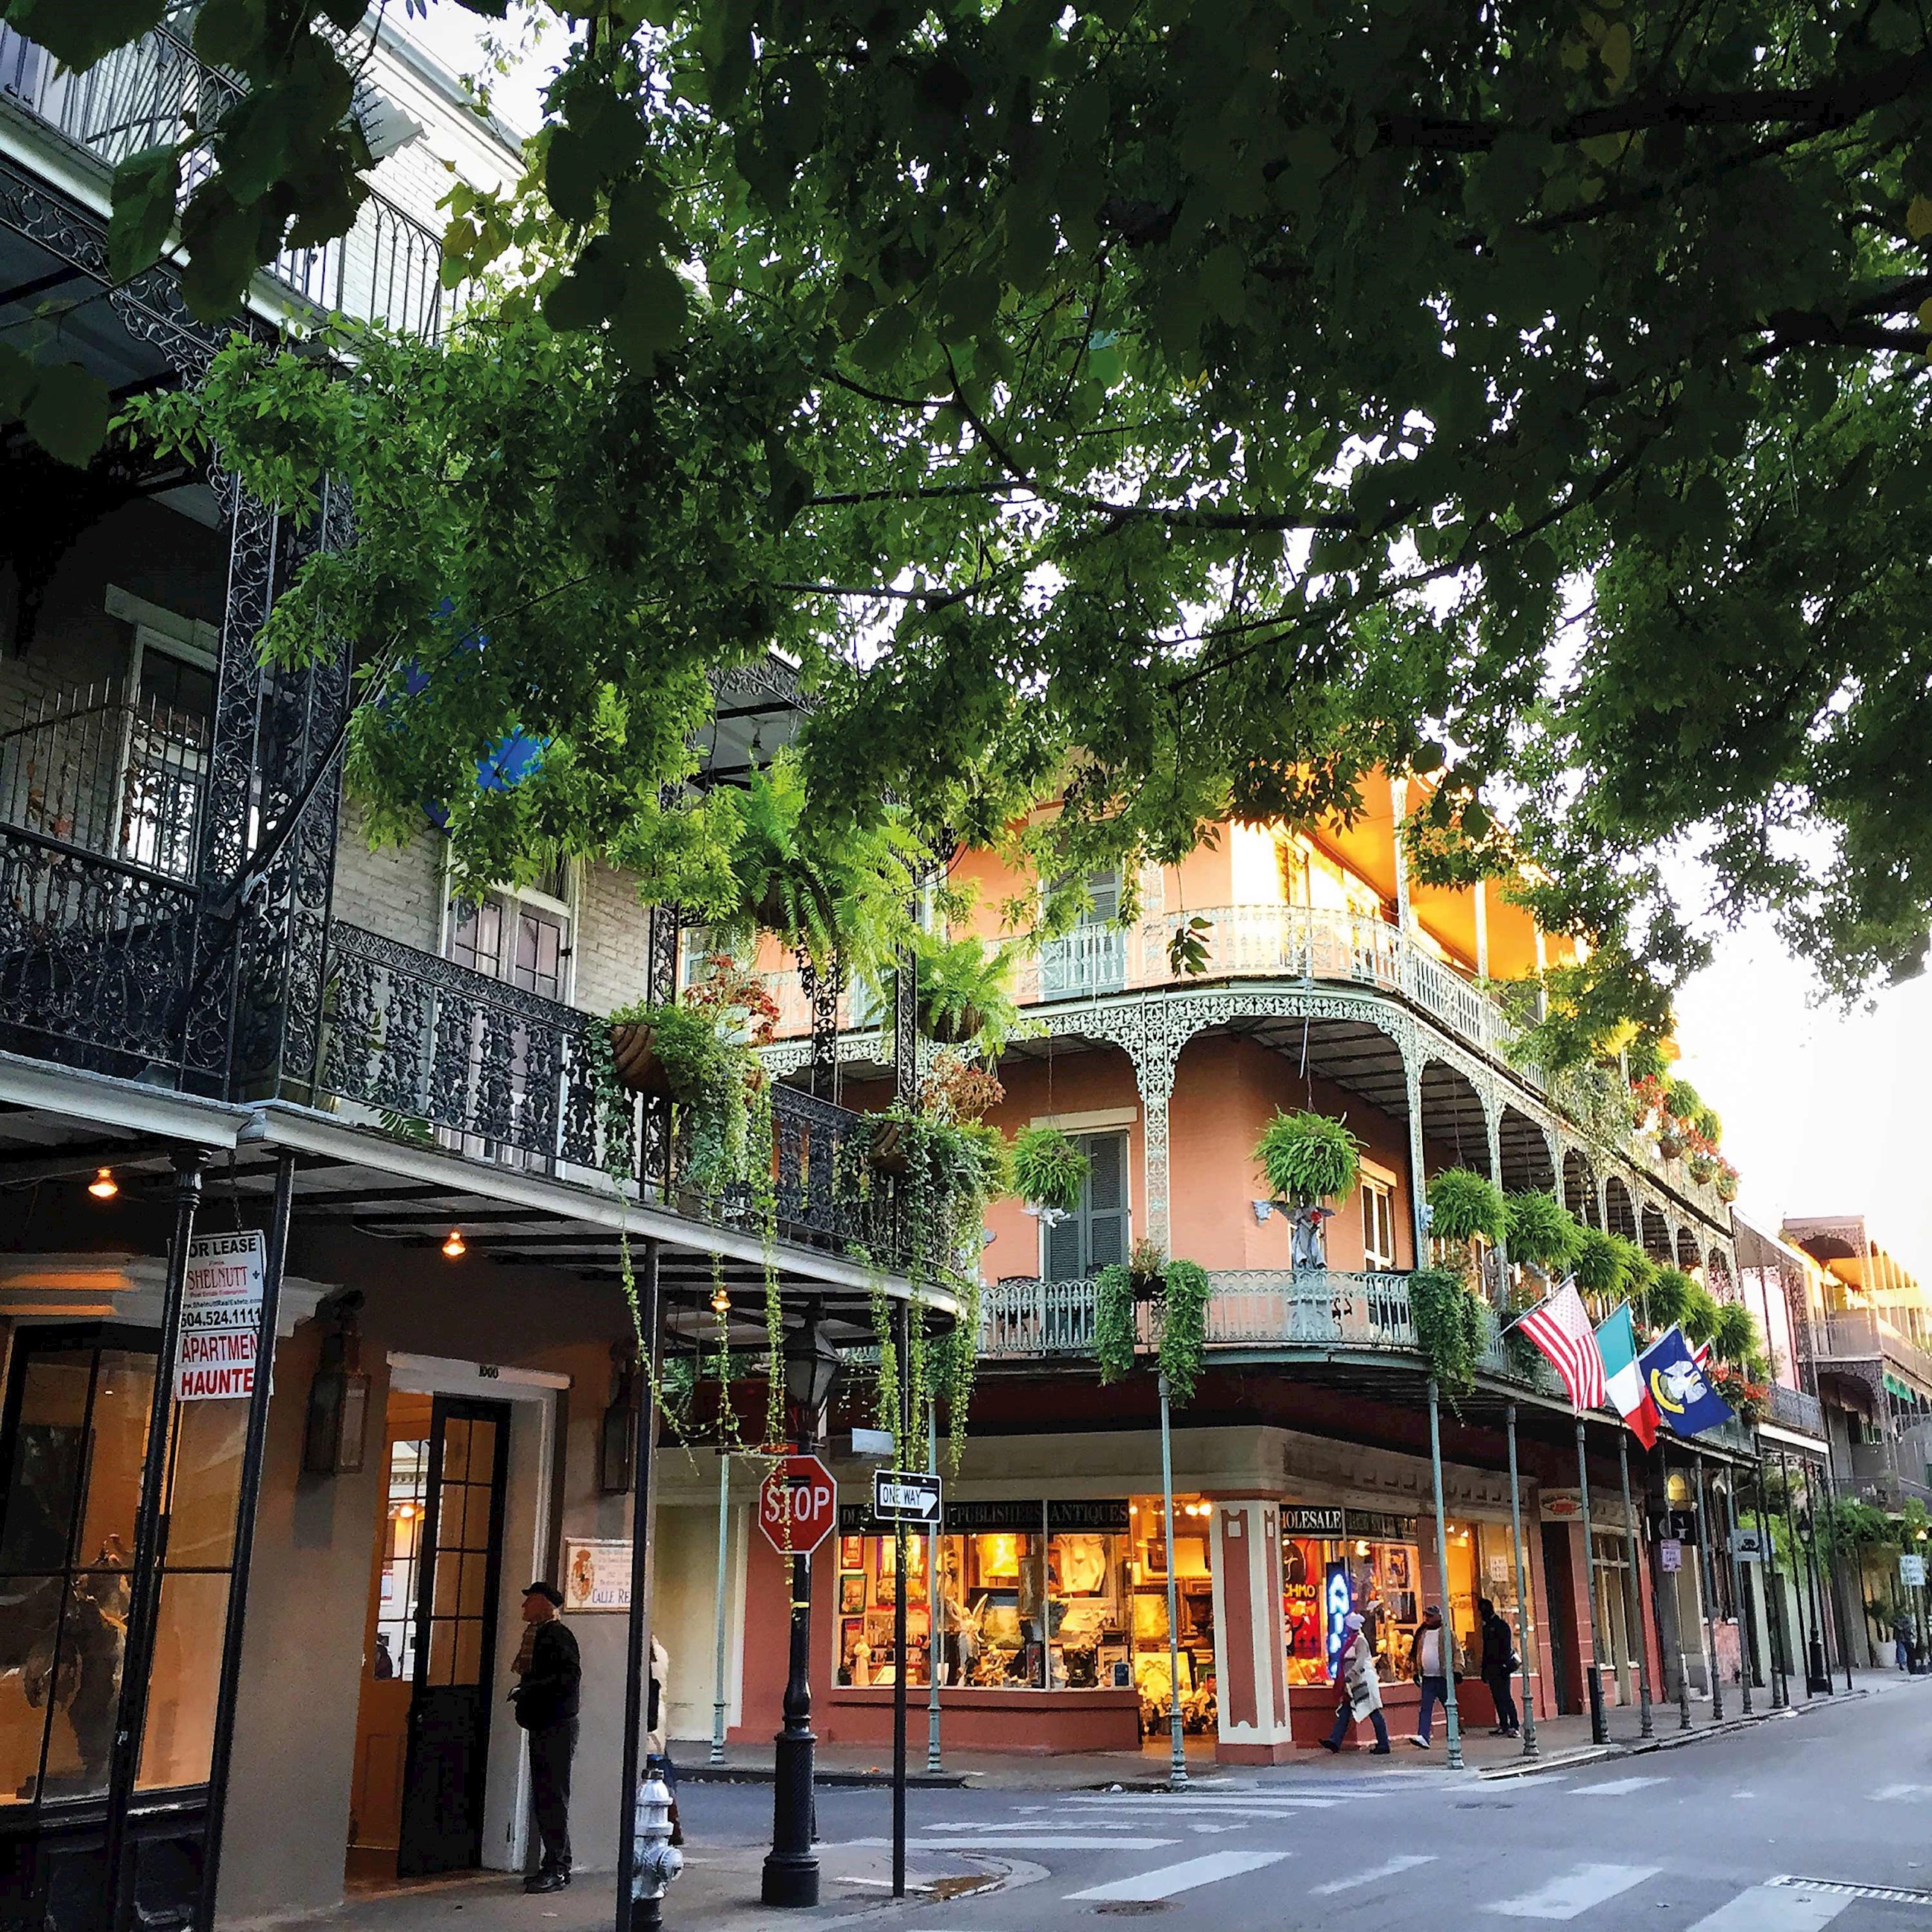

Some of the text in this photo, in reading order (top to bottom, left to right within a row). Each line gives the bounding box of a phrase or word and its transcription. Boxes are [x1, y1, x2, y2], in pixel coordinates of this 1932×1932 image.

[189, 1237, 257, 1258] OR LEASE
[187, 1266, 248, 1290] SHELNUTT
[182, 1334, 257, 1363] APARTMEN
[181, 1368, 254, 1396] HAUNTE
[479, 1365, 499, 1379] 1000
[765, 1486, 830, 1522] STOP
[883, 1486, 921, 1506] ONE WAY
[1049, 1503, 1128, 1525] ANTIQUES
[1280, 1510, 1342, 1529] HOLESALE
[592, 1588, 631, 1604] CALLE RE
[1283, 1582, 1316, 1598] CHMO
